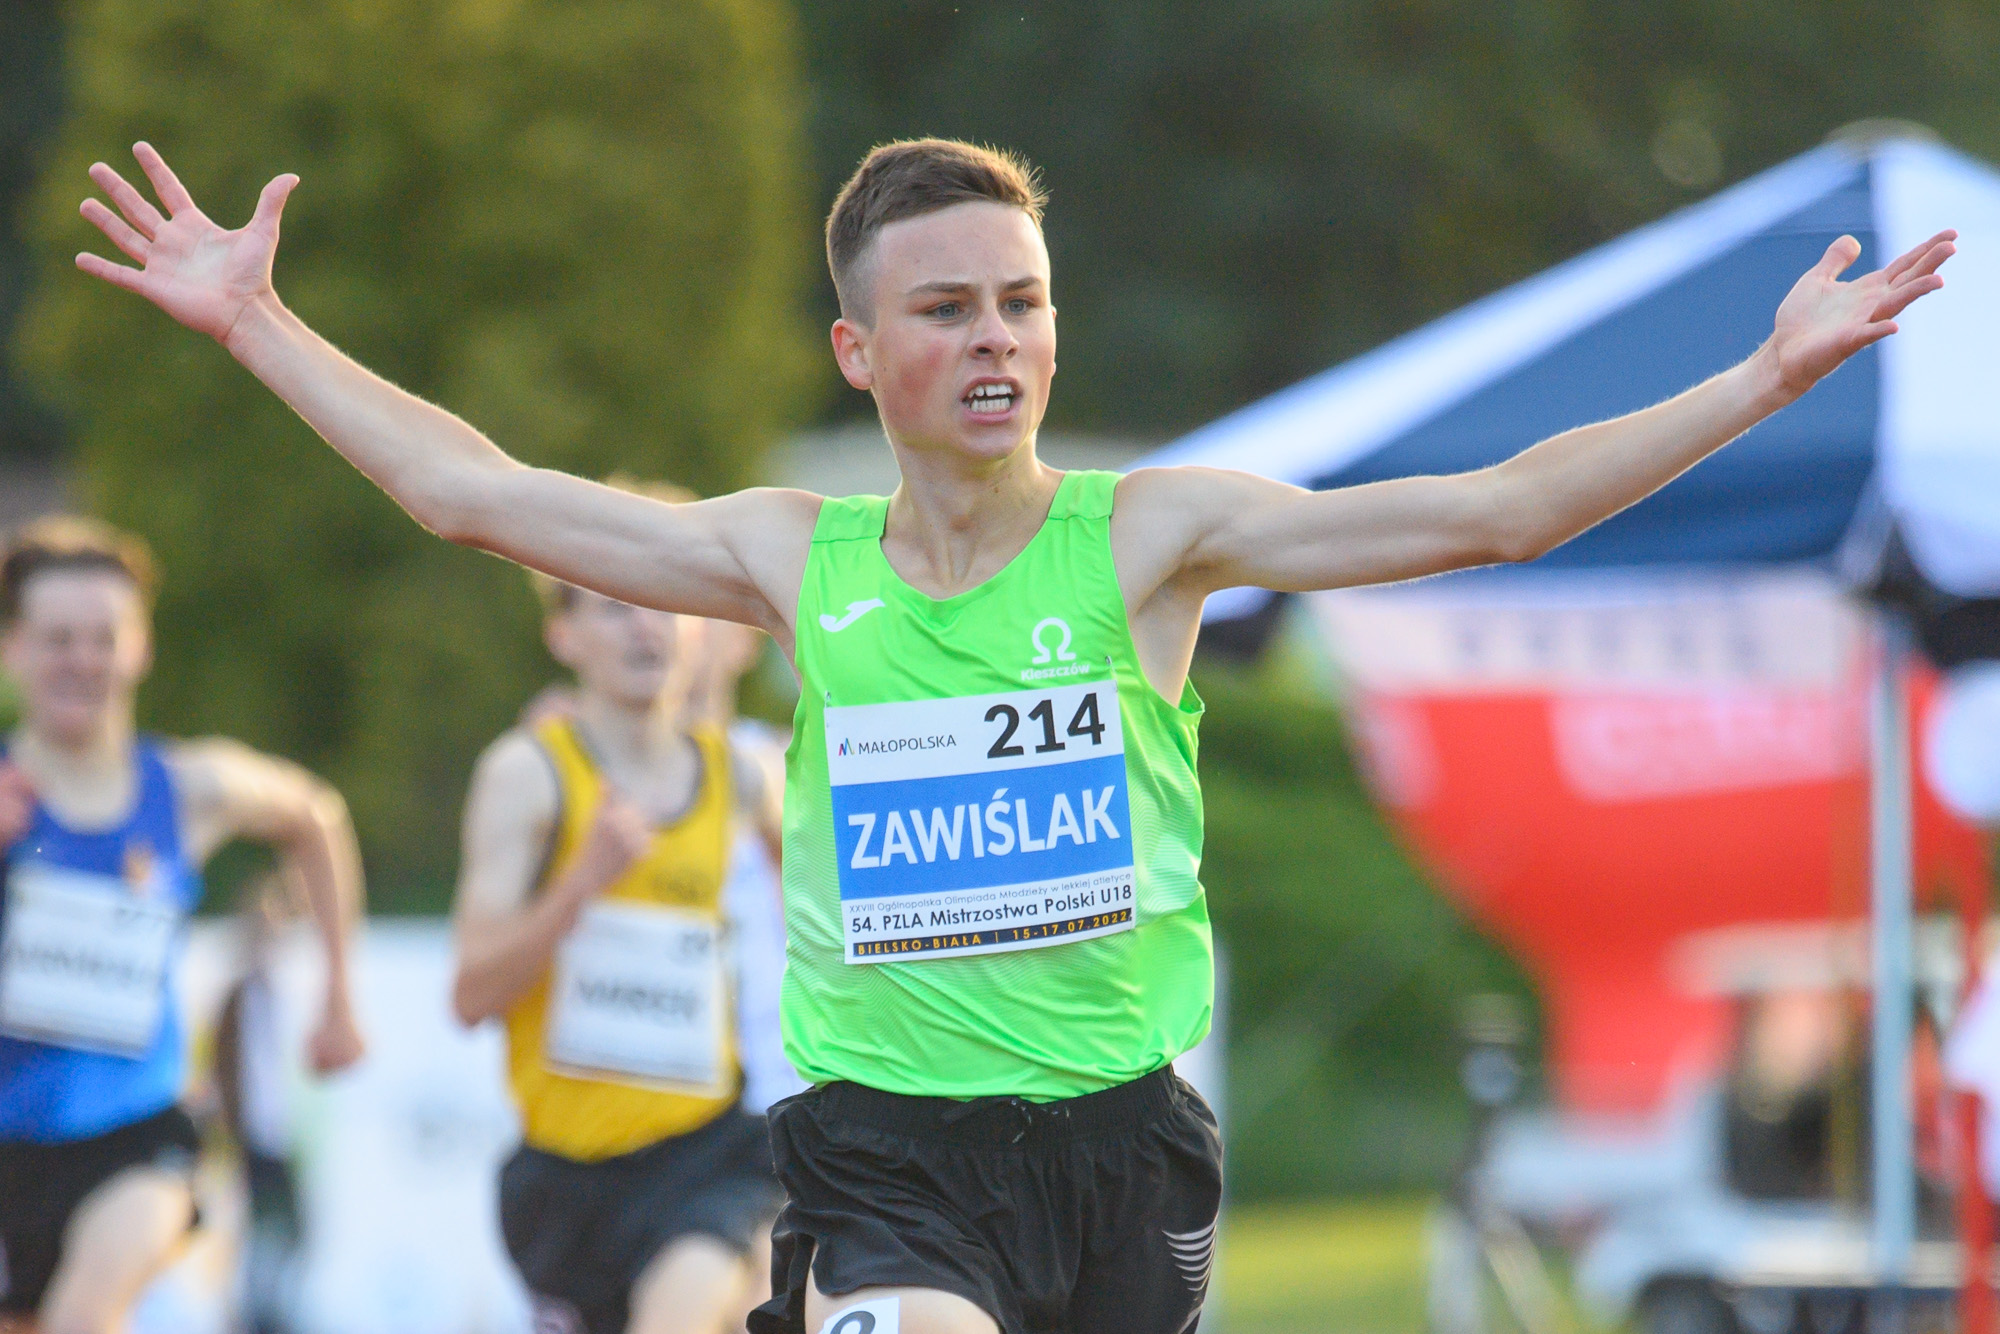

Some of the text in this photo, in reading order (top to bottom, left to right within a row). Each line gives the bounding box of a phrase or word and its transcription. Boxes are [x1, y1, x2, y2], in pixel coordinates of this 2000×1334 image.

[1020, 662, 1091, 681] Kleszczów
[858, 734, 957, 755] MAŁOPOLSKA
[983, 692, 1105, 759] 214
[848, 785, 1121, 869] ZAWIŚLAK
[849, 904, 875, 913] XXVIII
[877, 899, 942, 912] Ogólnopolska
[944, 892, 997, 904] Olimpiada
[1000, 887, 1048, 899] Młodzieży
[1061, 880, 1091, 890] lekkiej
[1093, 873, 1131, 886] atletyce
[852, 884, 1132, 933] 54. PZLA Mistrzostwa Polski U18
[858, 934, 981, 955] BIELSKO-BIAŁA
